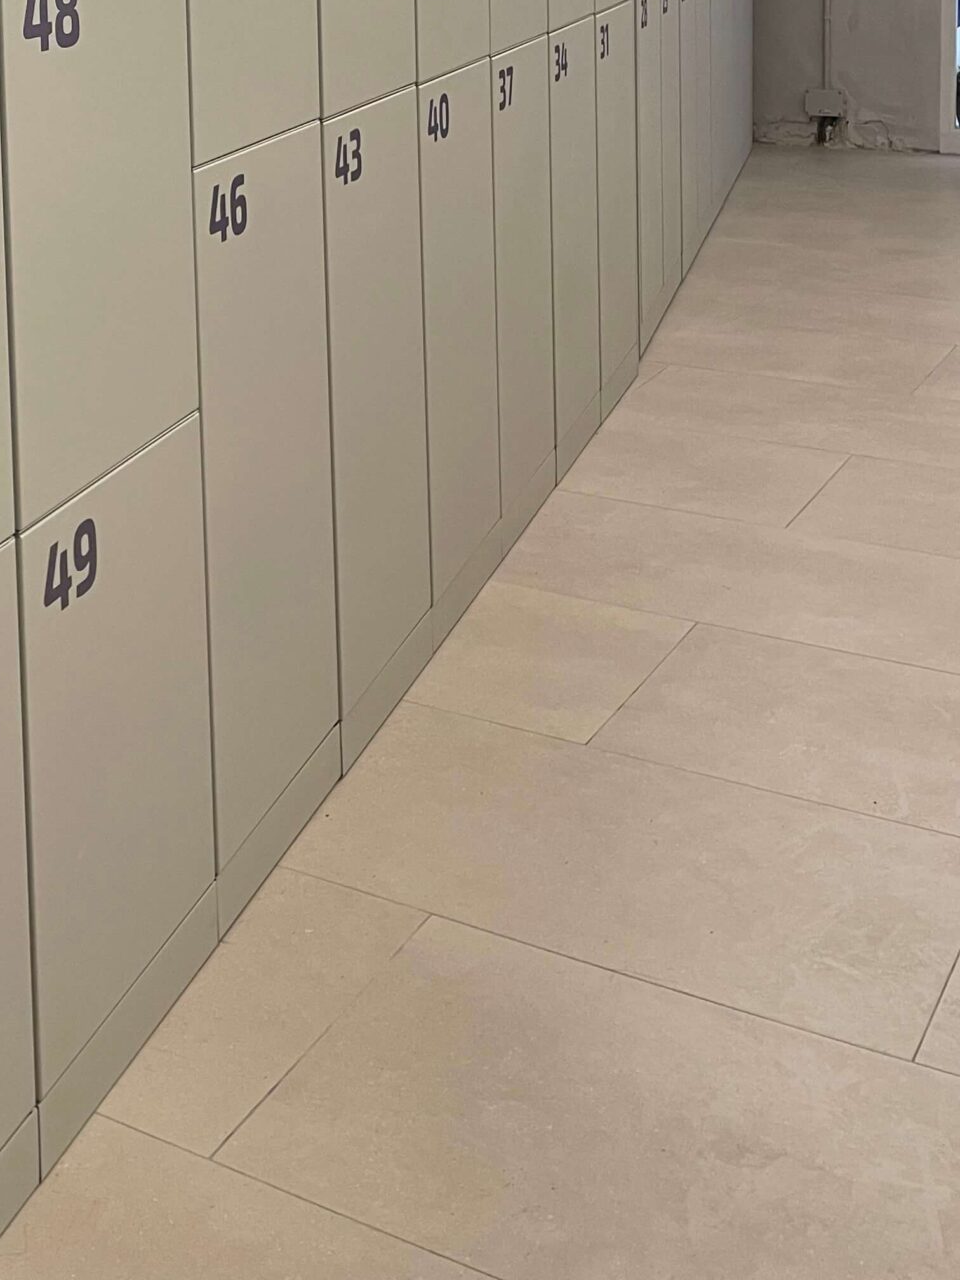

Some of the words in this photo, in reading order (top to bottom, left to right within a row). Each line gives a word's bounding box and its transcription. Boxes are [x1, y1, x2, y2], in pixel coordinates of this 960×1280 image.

[554, 42, 568, 82] 34
[600, 23, 609, 59] 31
[498, 66, 514, 111] 37
[427, 93, 450, 142] 40
[335, 128, 362, 186] 43
[209, 173, 248, 242] 46
[43, 517, 97, 610] 49
